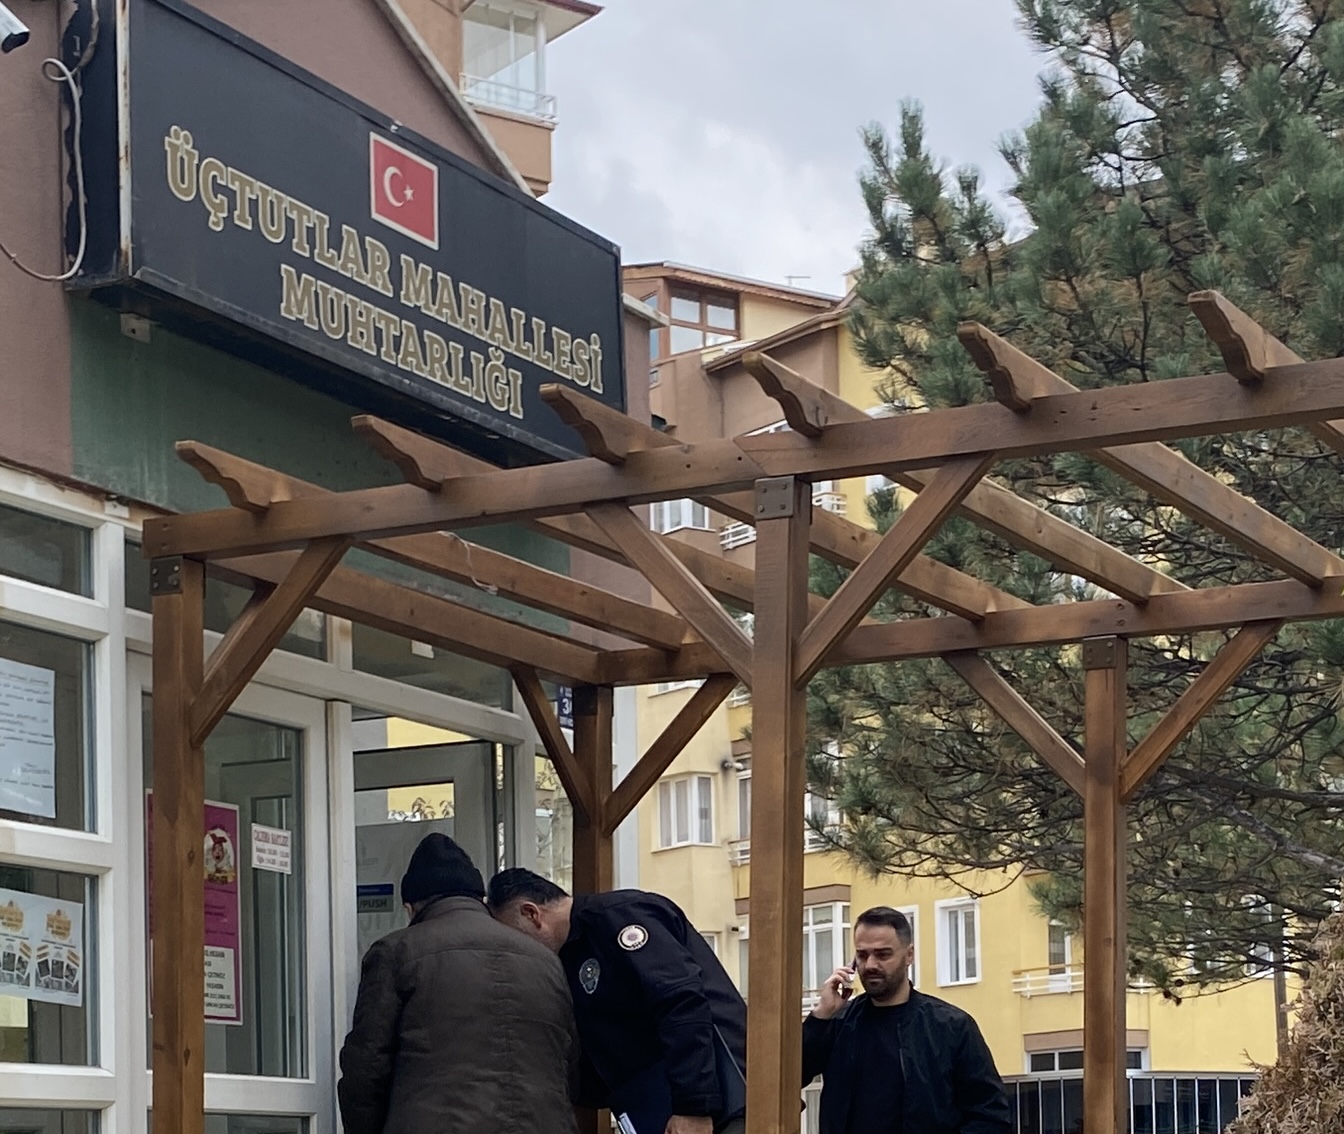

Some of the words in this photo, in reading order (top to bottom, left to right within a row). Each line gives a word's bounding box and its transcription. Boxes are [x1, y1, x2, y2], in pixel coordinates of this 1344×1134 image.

[164, 124, 394, 298] ÜÇTUTLAR
[399, 251, 604, 394] MAHALLESİ
[280, 263, 524, 419] MUHTARLIĞI
